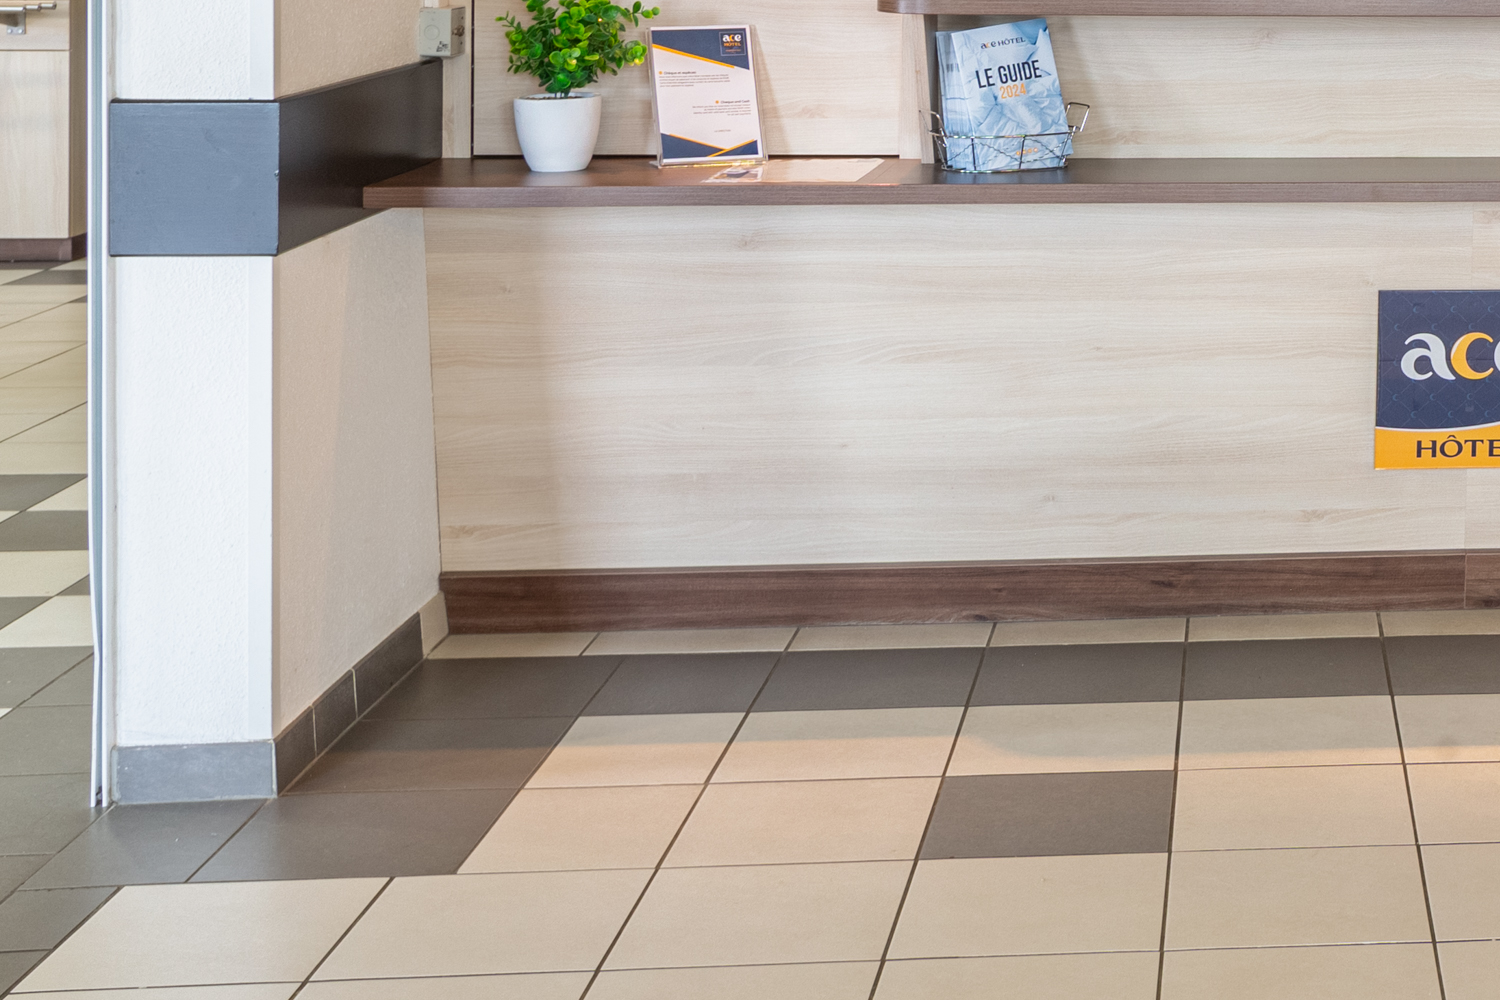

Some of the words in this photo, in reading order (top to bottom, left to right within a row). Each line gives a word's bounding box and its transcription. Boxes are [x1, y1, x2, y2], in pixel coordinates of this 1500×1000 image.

[722, 34, 742, 42] ace
[980, 38, 997, 50] ace
[997, 36, 1026, 47] HÔTEL
[975, 68, 995, 89] LE
[997, 59, 1042, 85] GUIDE
[999, 83, 1027, 99] 2024
